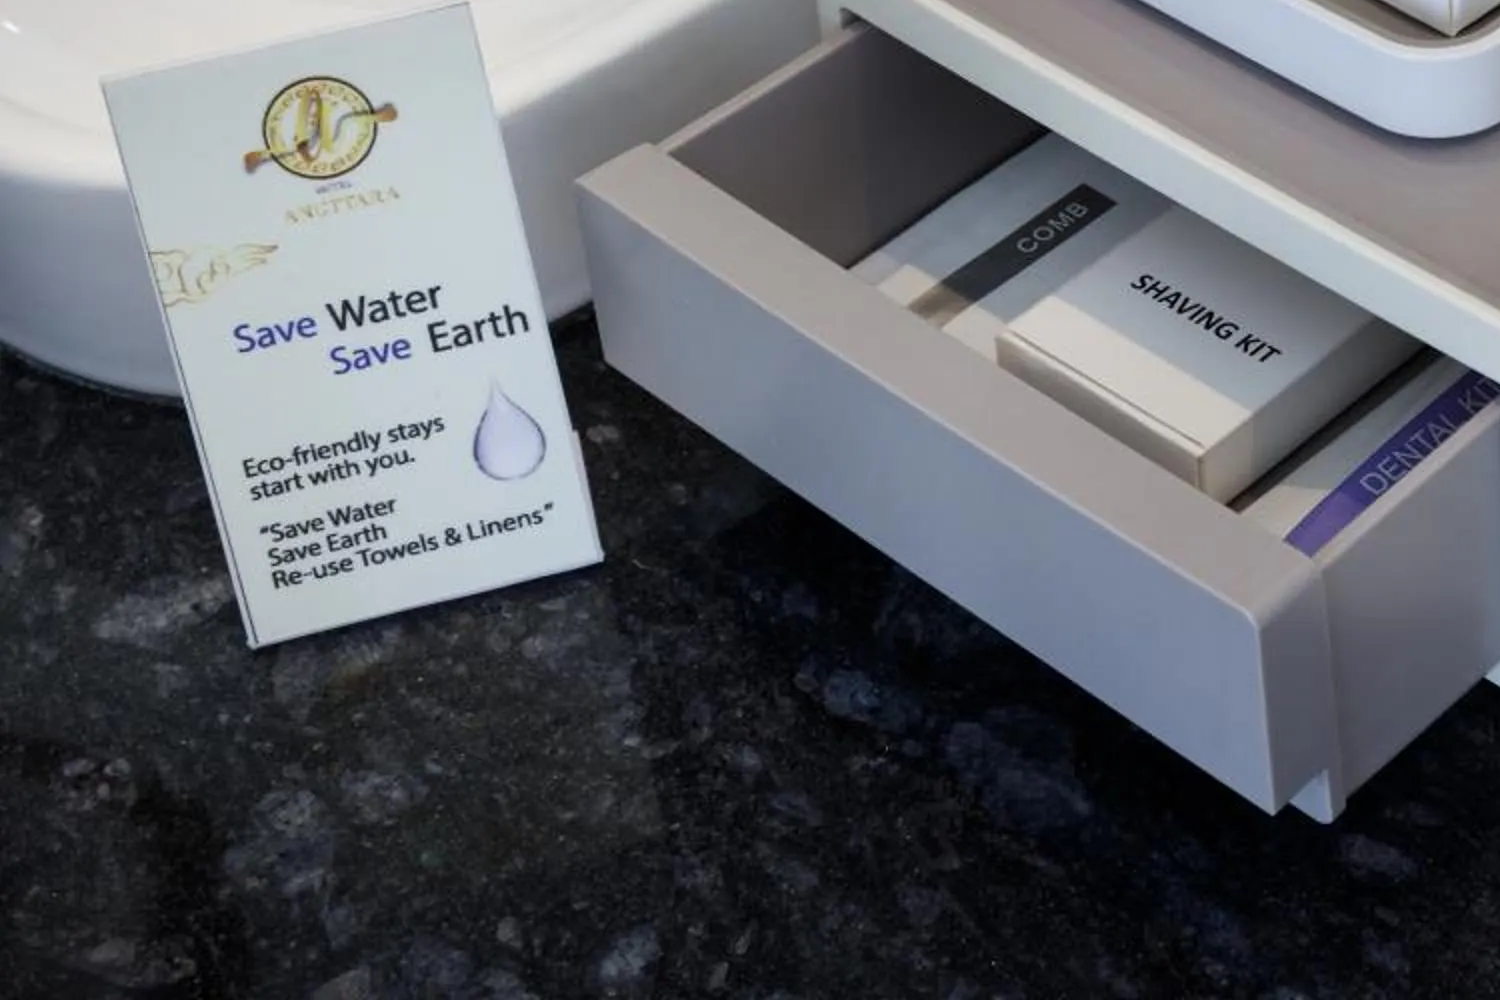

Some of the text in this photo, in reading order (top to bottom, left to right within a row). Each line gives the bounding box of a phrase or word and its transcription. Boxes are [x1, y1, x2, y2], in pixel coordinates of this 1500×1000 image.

[1016, 200, 1089, 254] COMB
[232, 284, 443, 353] Save Water
[330, 303, 530, 375] Save Earth
[1130, 272, 1283, 364] SHAVING KIT
[242, 416, 446, 479] Eco-friendly stays
[250, 449, 415, 502] start with you.
[327, 498, 398, 528] Water
[267, 523, 388, 568] Save Earth
[271, 554, 355, 590] Re-use
[356, 533, 439, 569] Towels
[444, 527, 463, 548] &
